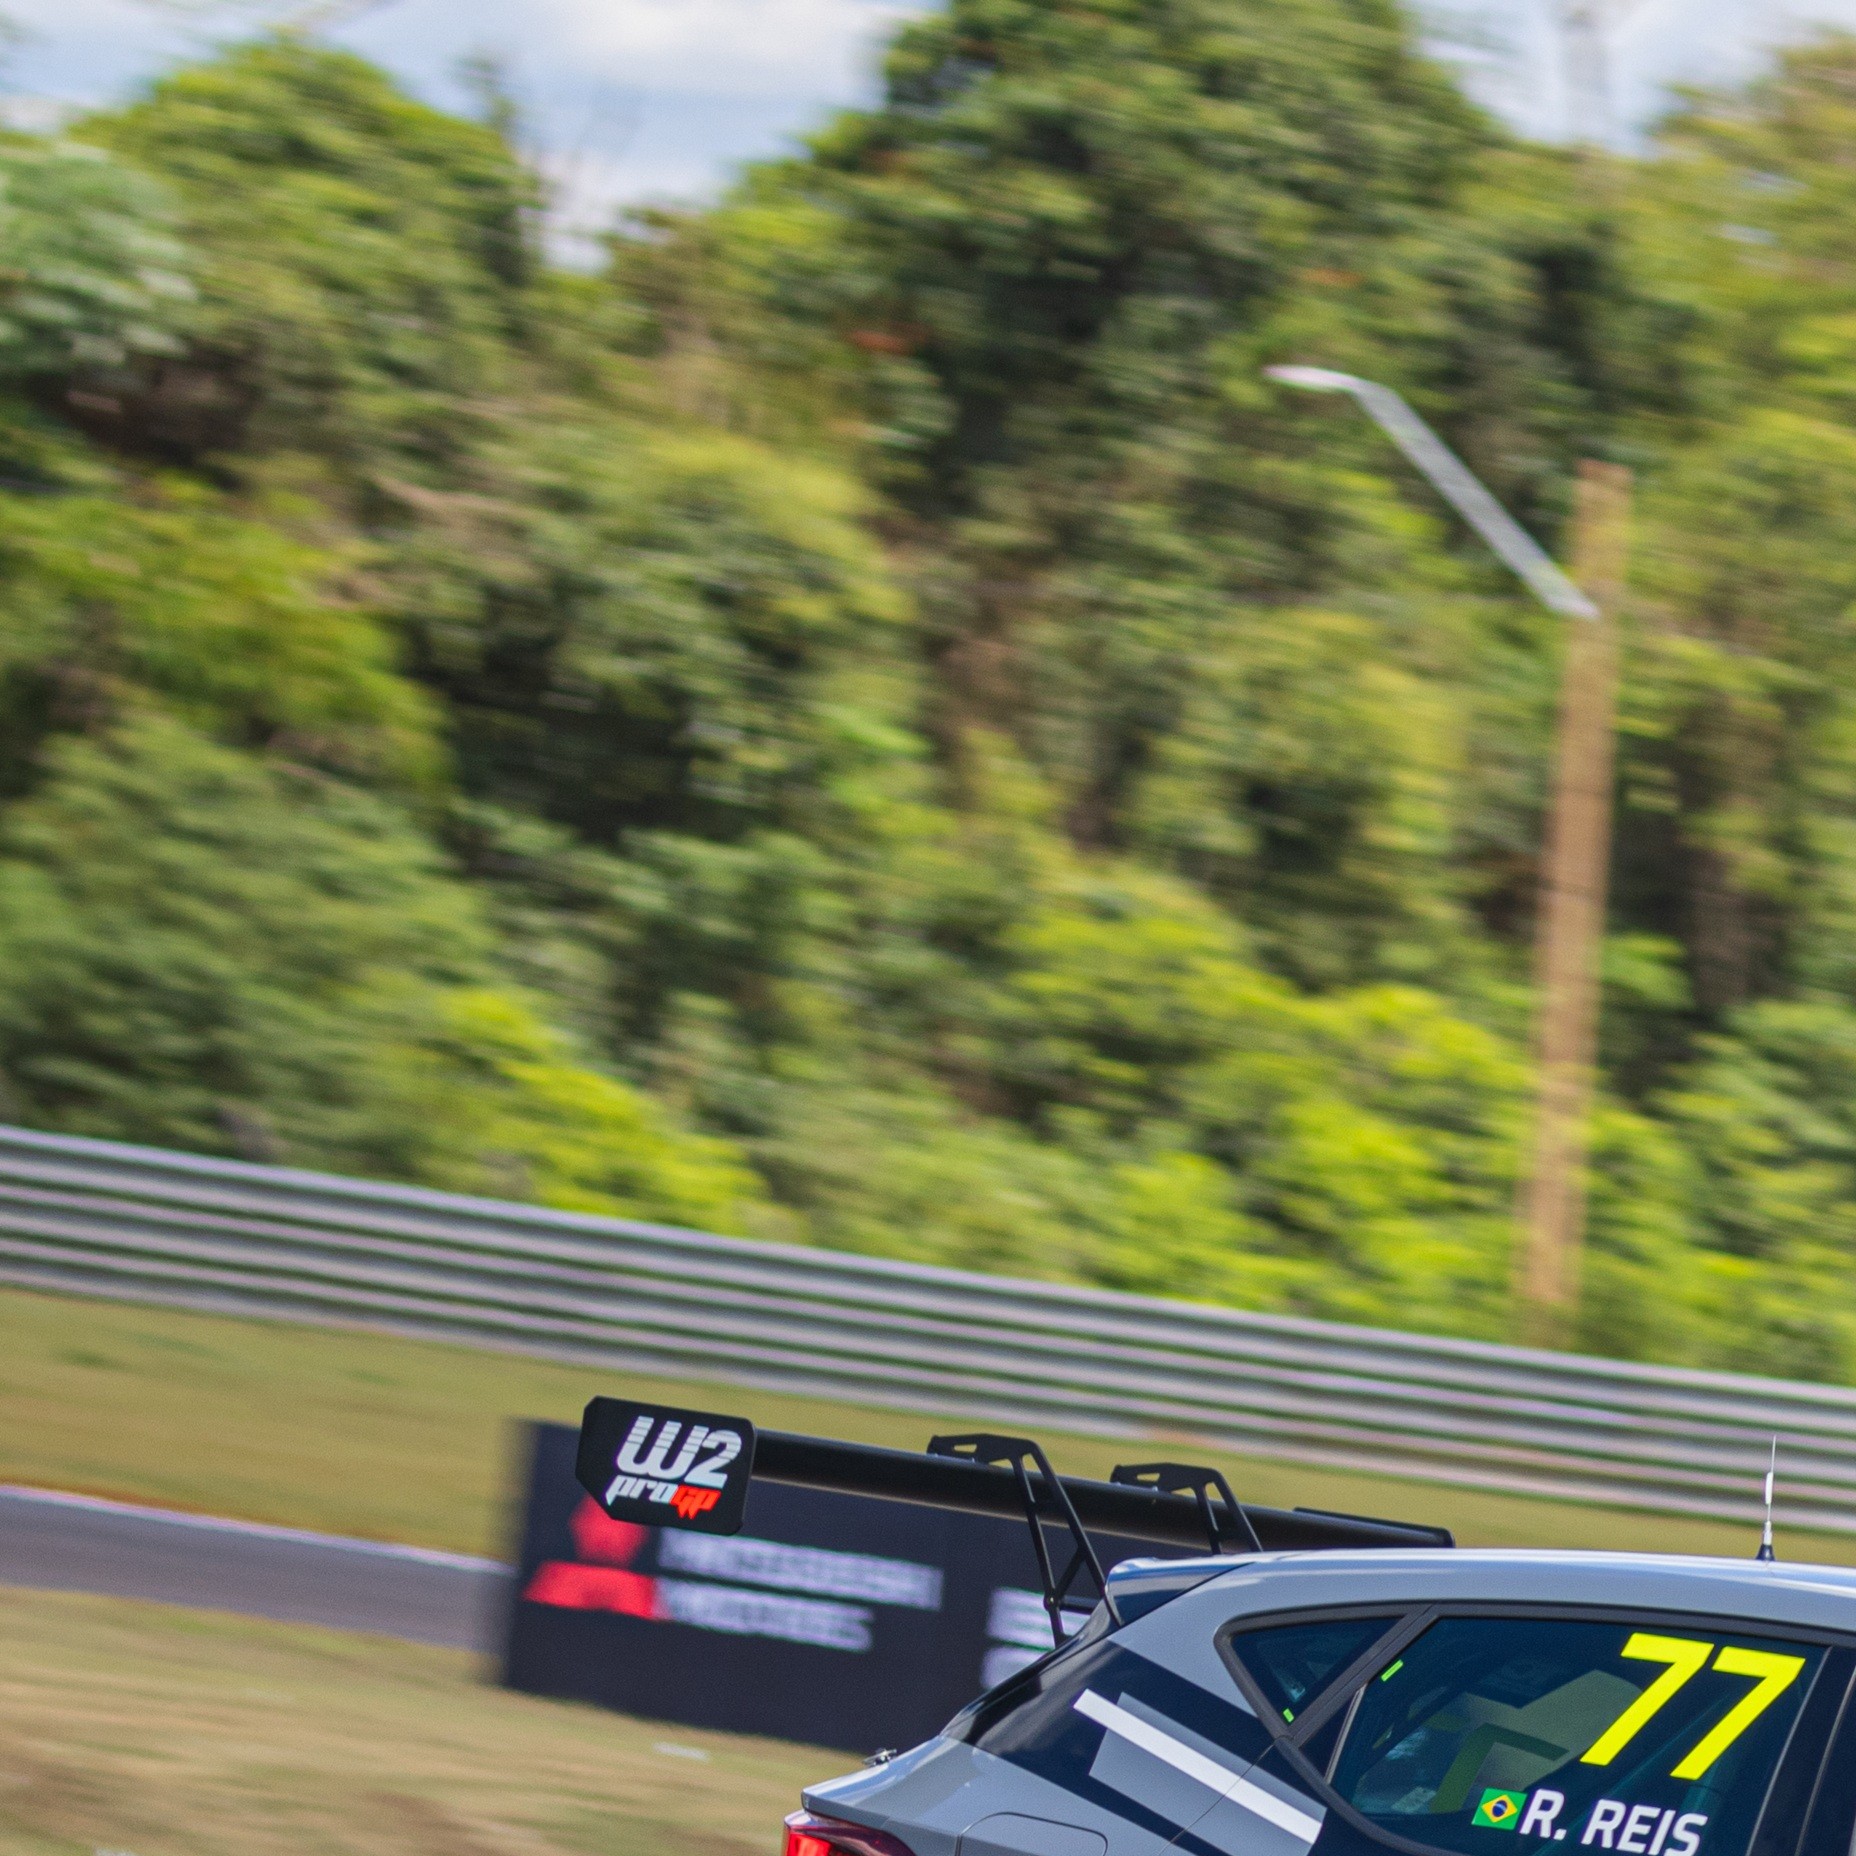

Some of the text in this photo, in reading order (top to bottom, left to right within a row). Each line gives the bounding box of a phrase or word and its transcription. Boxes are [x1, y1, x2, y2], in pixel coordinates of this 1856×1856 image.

[617, 1415, 742, 1489] W2
[1580, 1632, 1805, 1780] 77
[1520, 1788, 1567, 1840] R.
